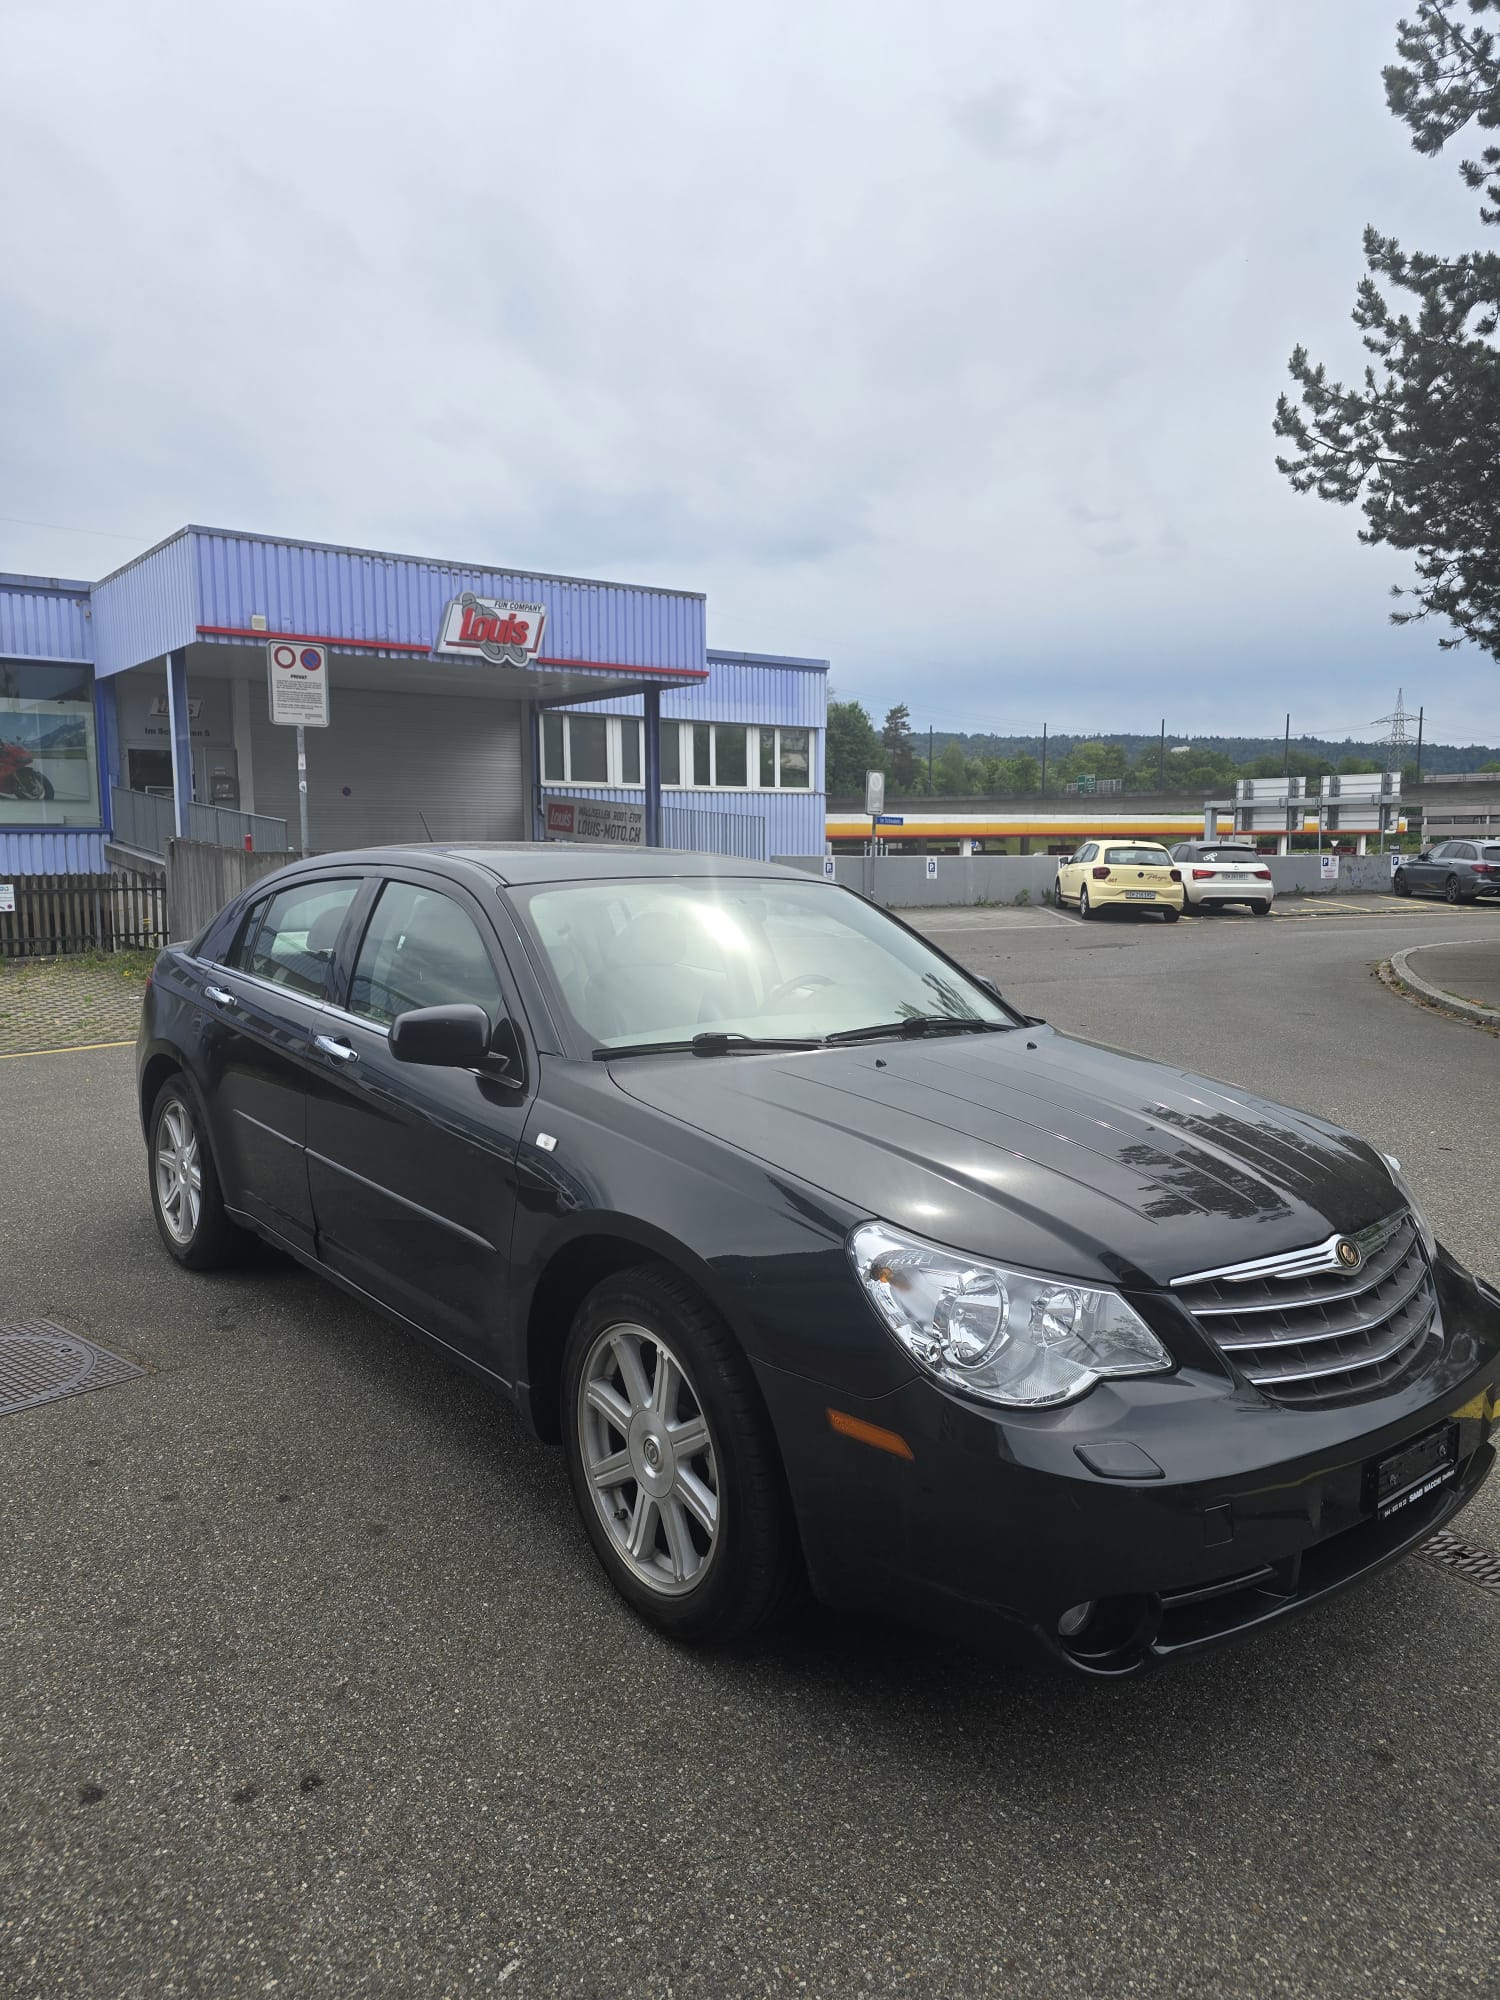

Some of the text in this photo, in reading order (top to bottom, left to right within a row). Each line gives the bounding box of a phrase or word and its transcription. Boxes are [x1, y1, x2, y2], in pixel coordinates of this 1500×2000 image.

[494, 600, 542, 612] FUN COMPANY
[459, 607, 530, 646] Louis
[577, 819, 642, 843] LOUIS-MOTO.CH
